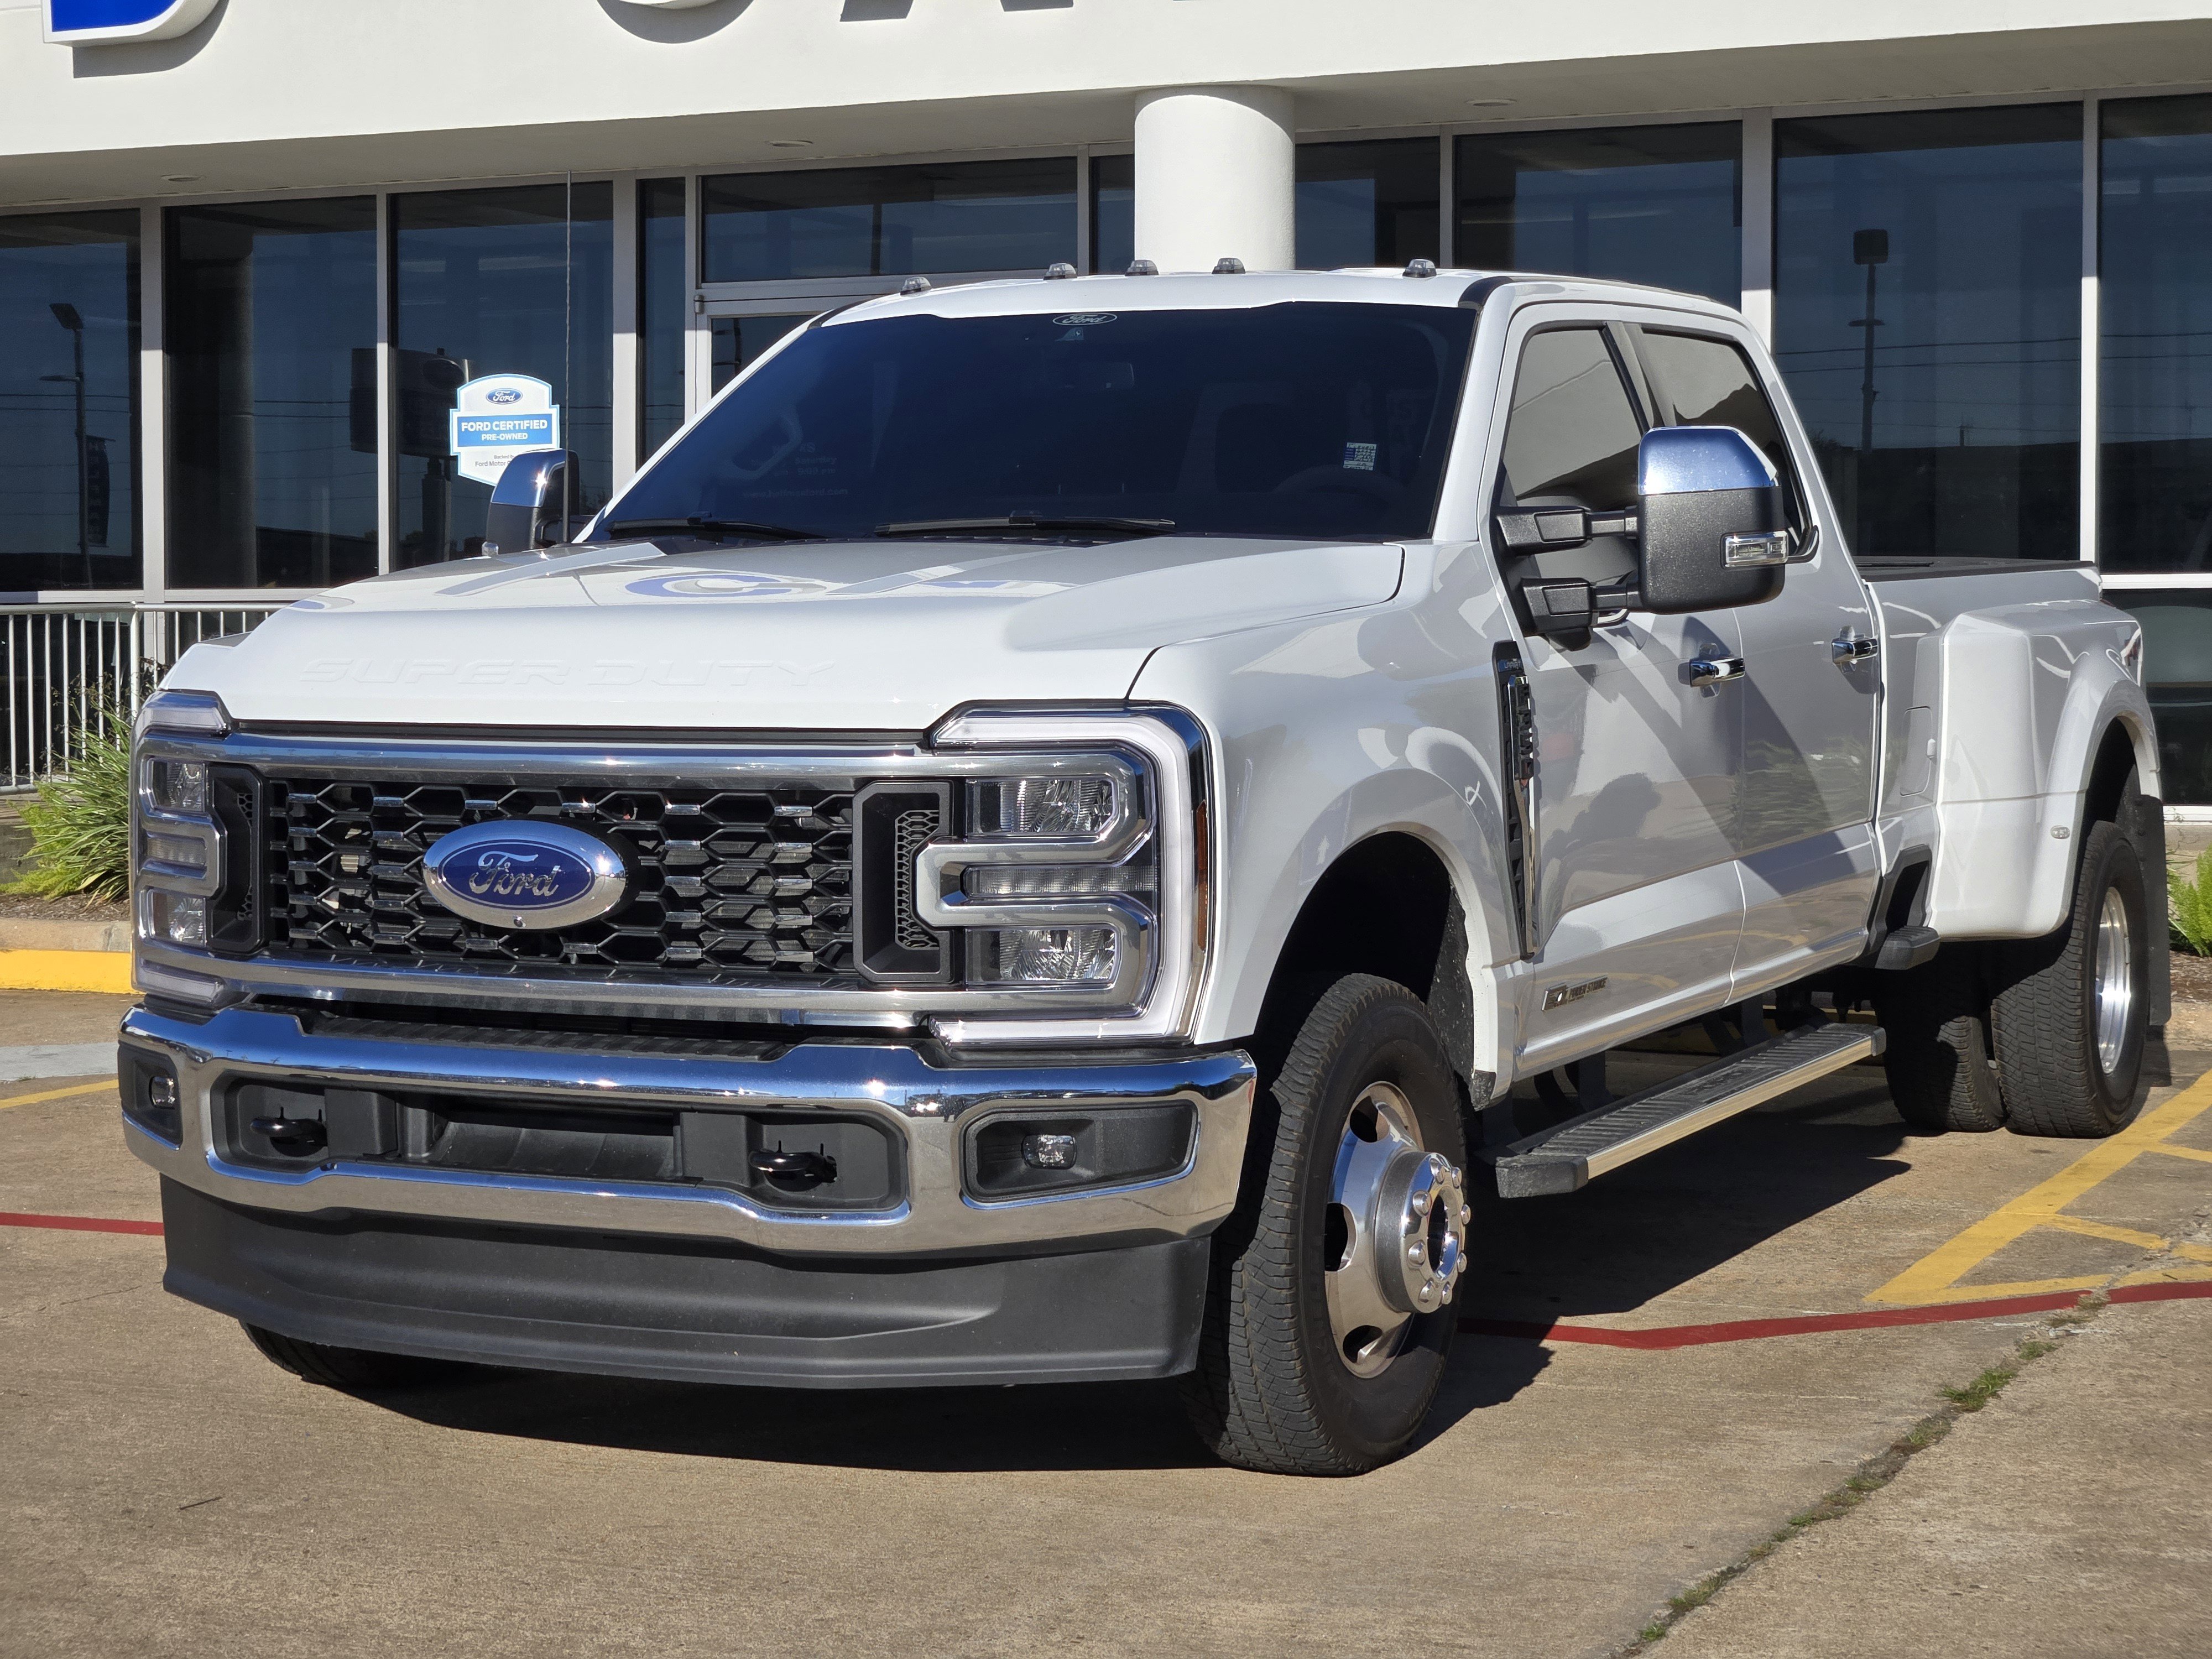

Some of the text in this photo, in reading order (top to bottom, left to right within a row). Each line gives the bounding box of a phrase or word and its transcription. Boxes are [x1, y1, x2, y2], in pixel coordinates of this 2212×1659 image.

[1062, 314, 1107, 324] Ford
[493, 391, 515, 401] Ford
[461, 419, 547, 432] FORD CERTIFIED
[482, 432, 528, 441] PRE-OWNED
[299, 658, 837, 687] SUPER DUTY
[469, 851, 562, 897] Ford
